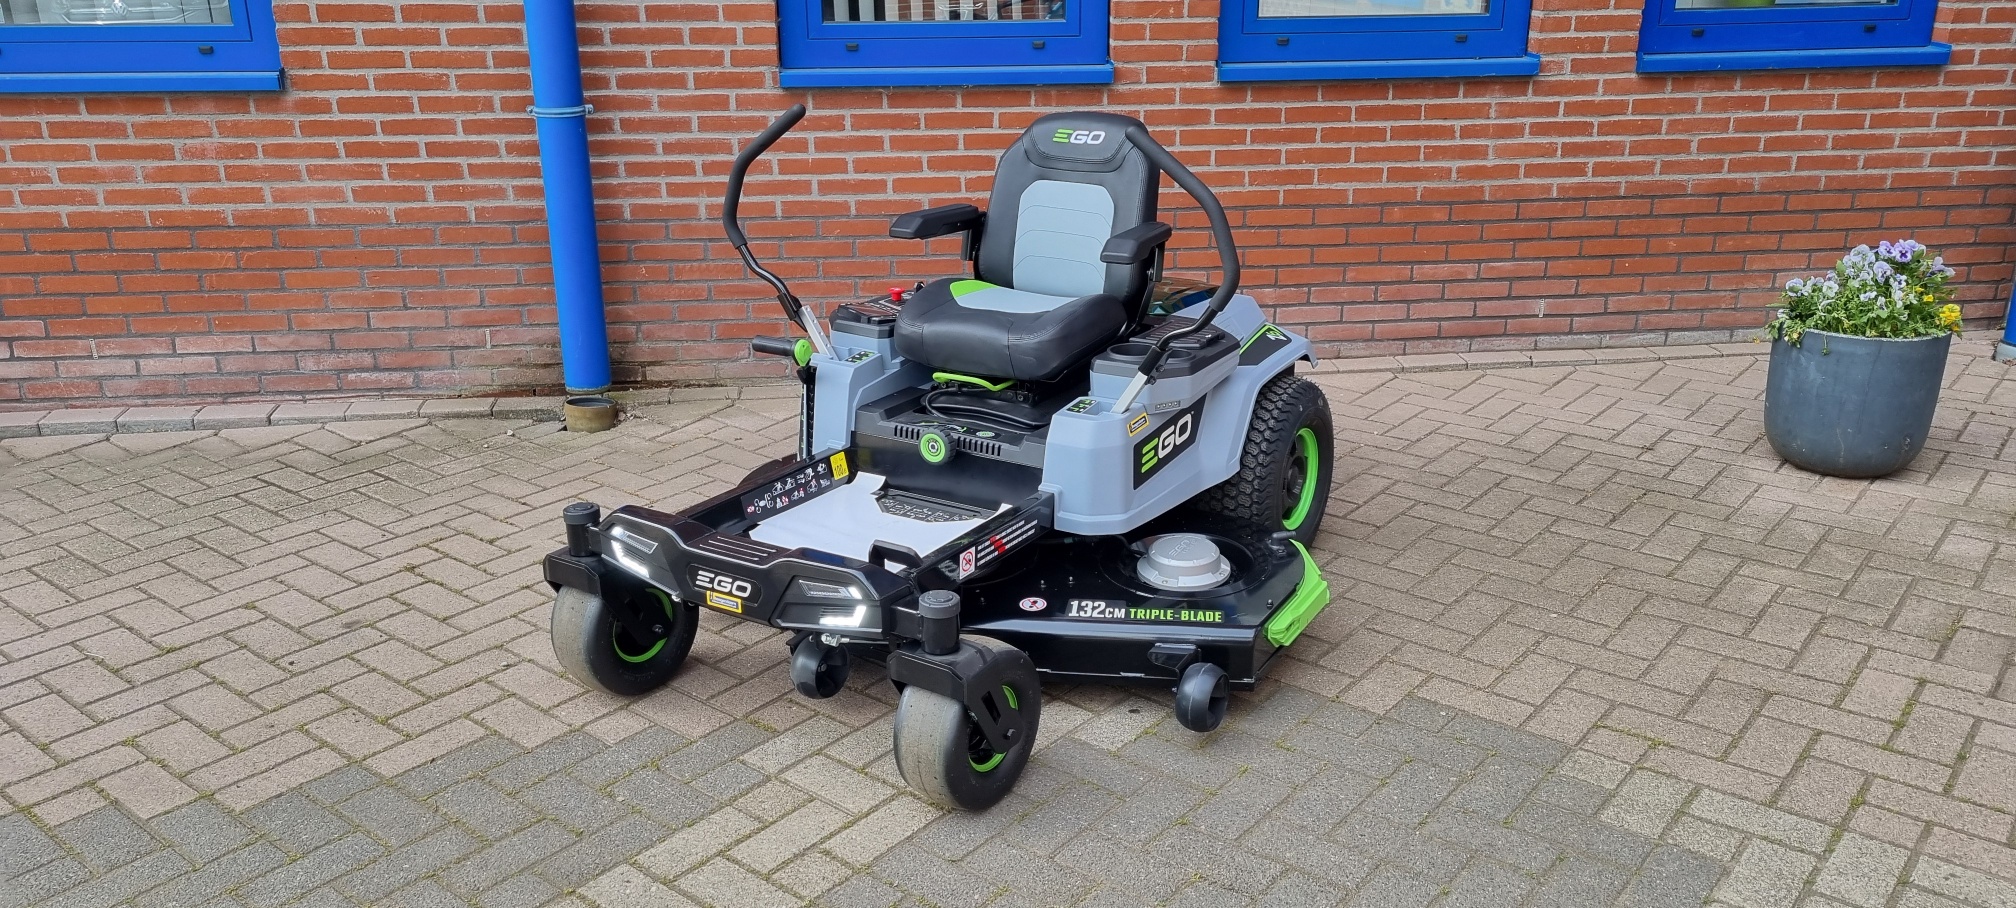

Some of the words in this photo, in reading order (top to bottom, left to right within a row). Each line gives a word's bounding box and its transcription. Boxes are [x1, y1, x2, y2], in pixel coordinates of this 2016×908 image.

[1052, 128, 1106, 144] EGO
[1141, 413, 1192, 474] EGO
[695, 570, 752, 598] EGO
[1129, 608, 1222, 622] TRIPLE-BLADE
